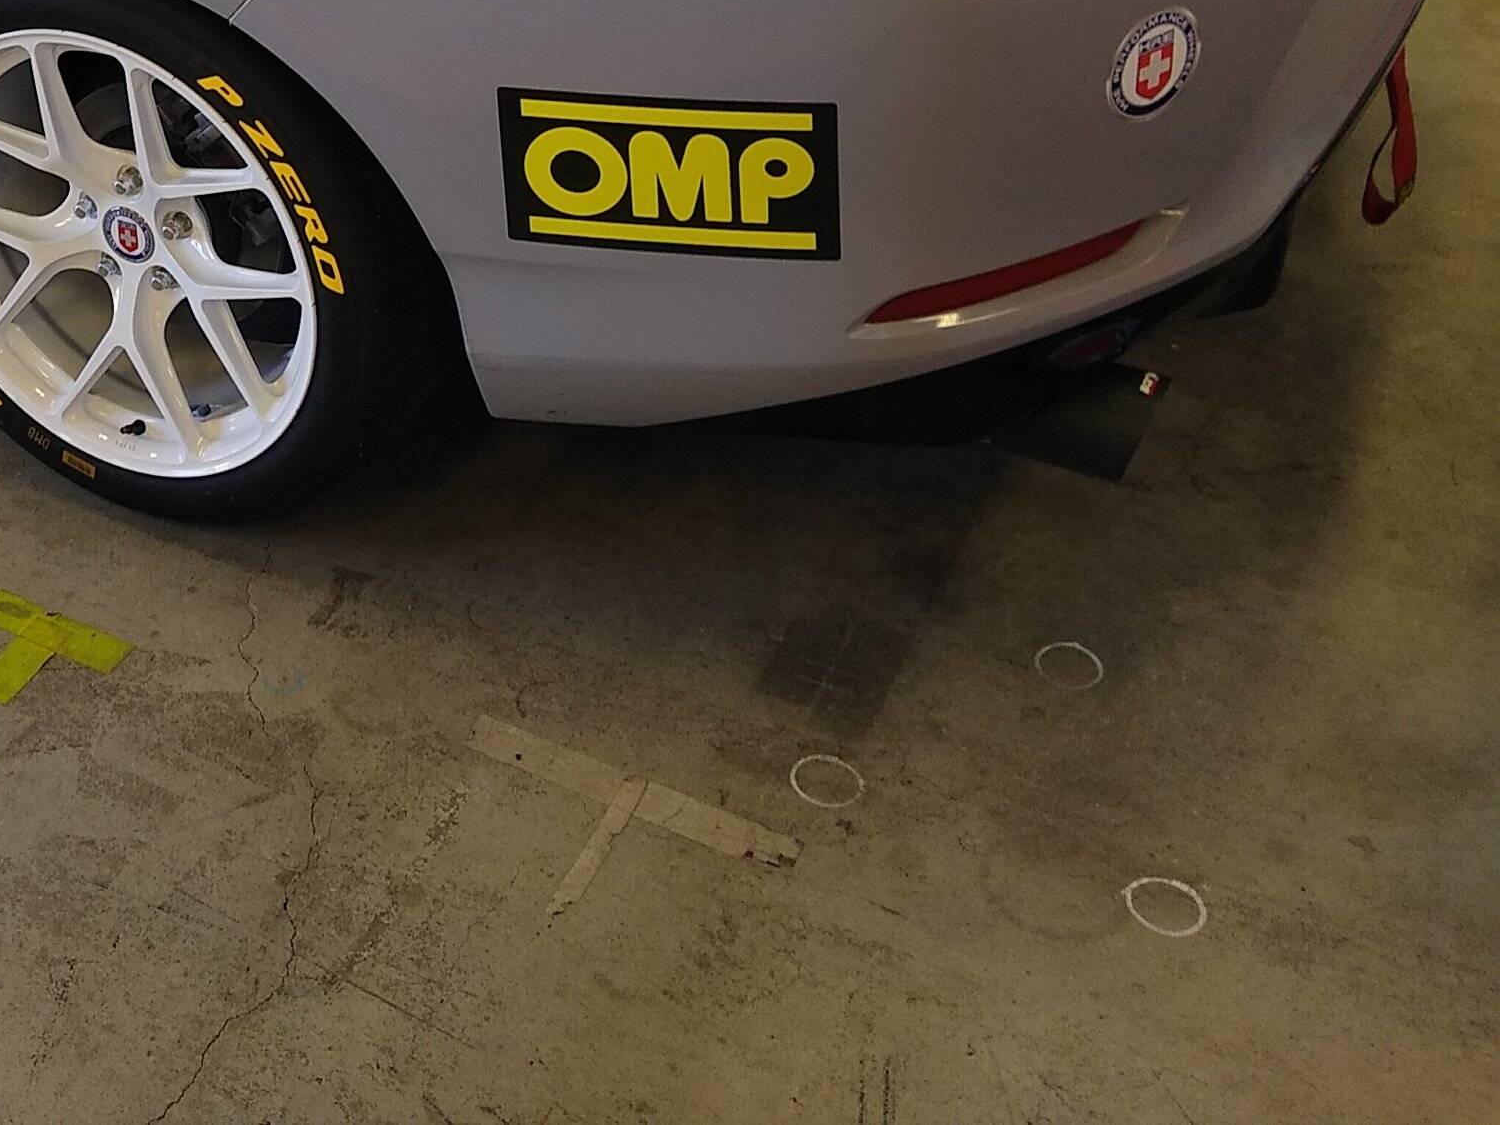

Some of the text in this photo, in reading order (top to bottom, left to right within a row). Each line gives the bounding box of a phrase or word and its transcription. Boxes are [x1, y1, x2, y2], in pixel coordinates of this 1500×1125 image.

[196, 75, 346, 296] P ZERO
[523, 125, 816, 225] OMP
